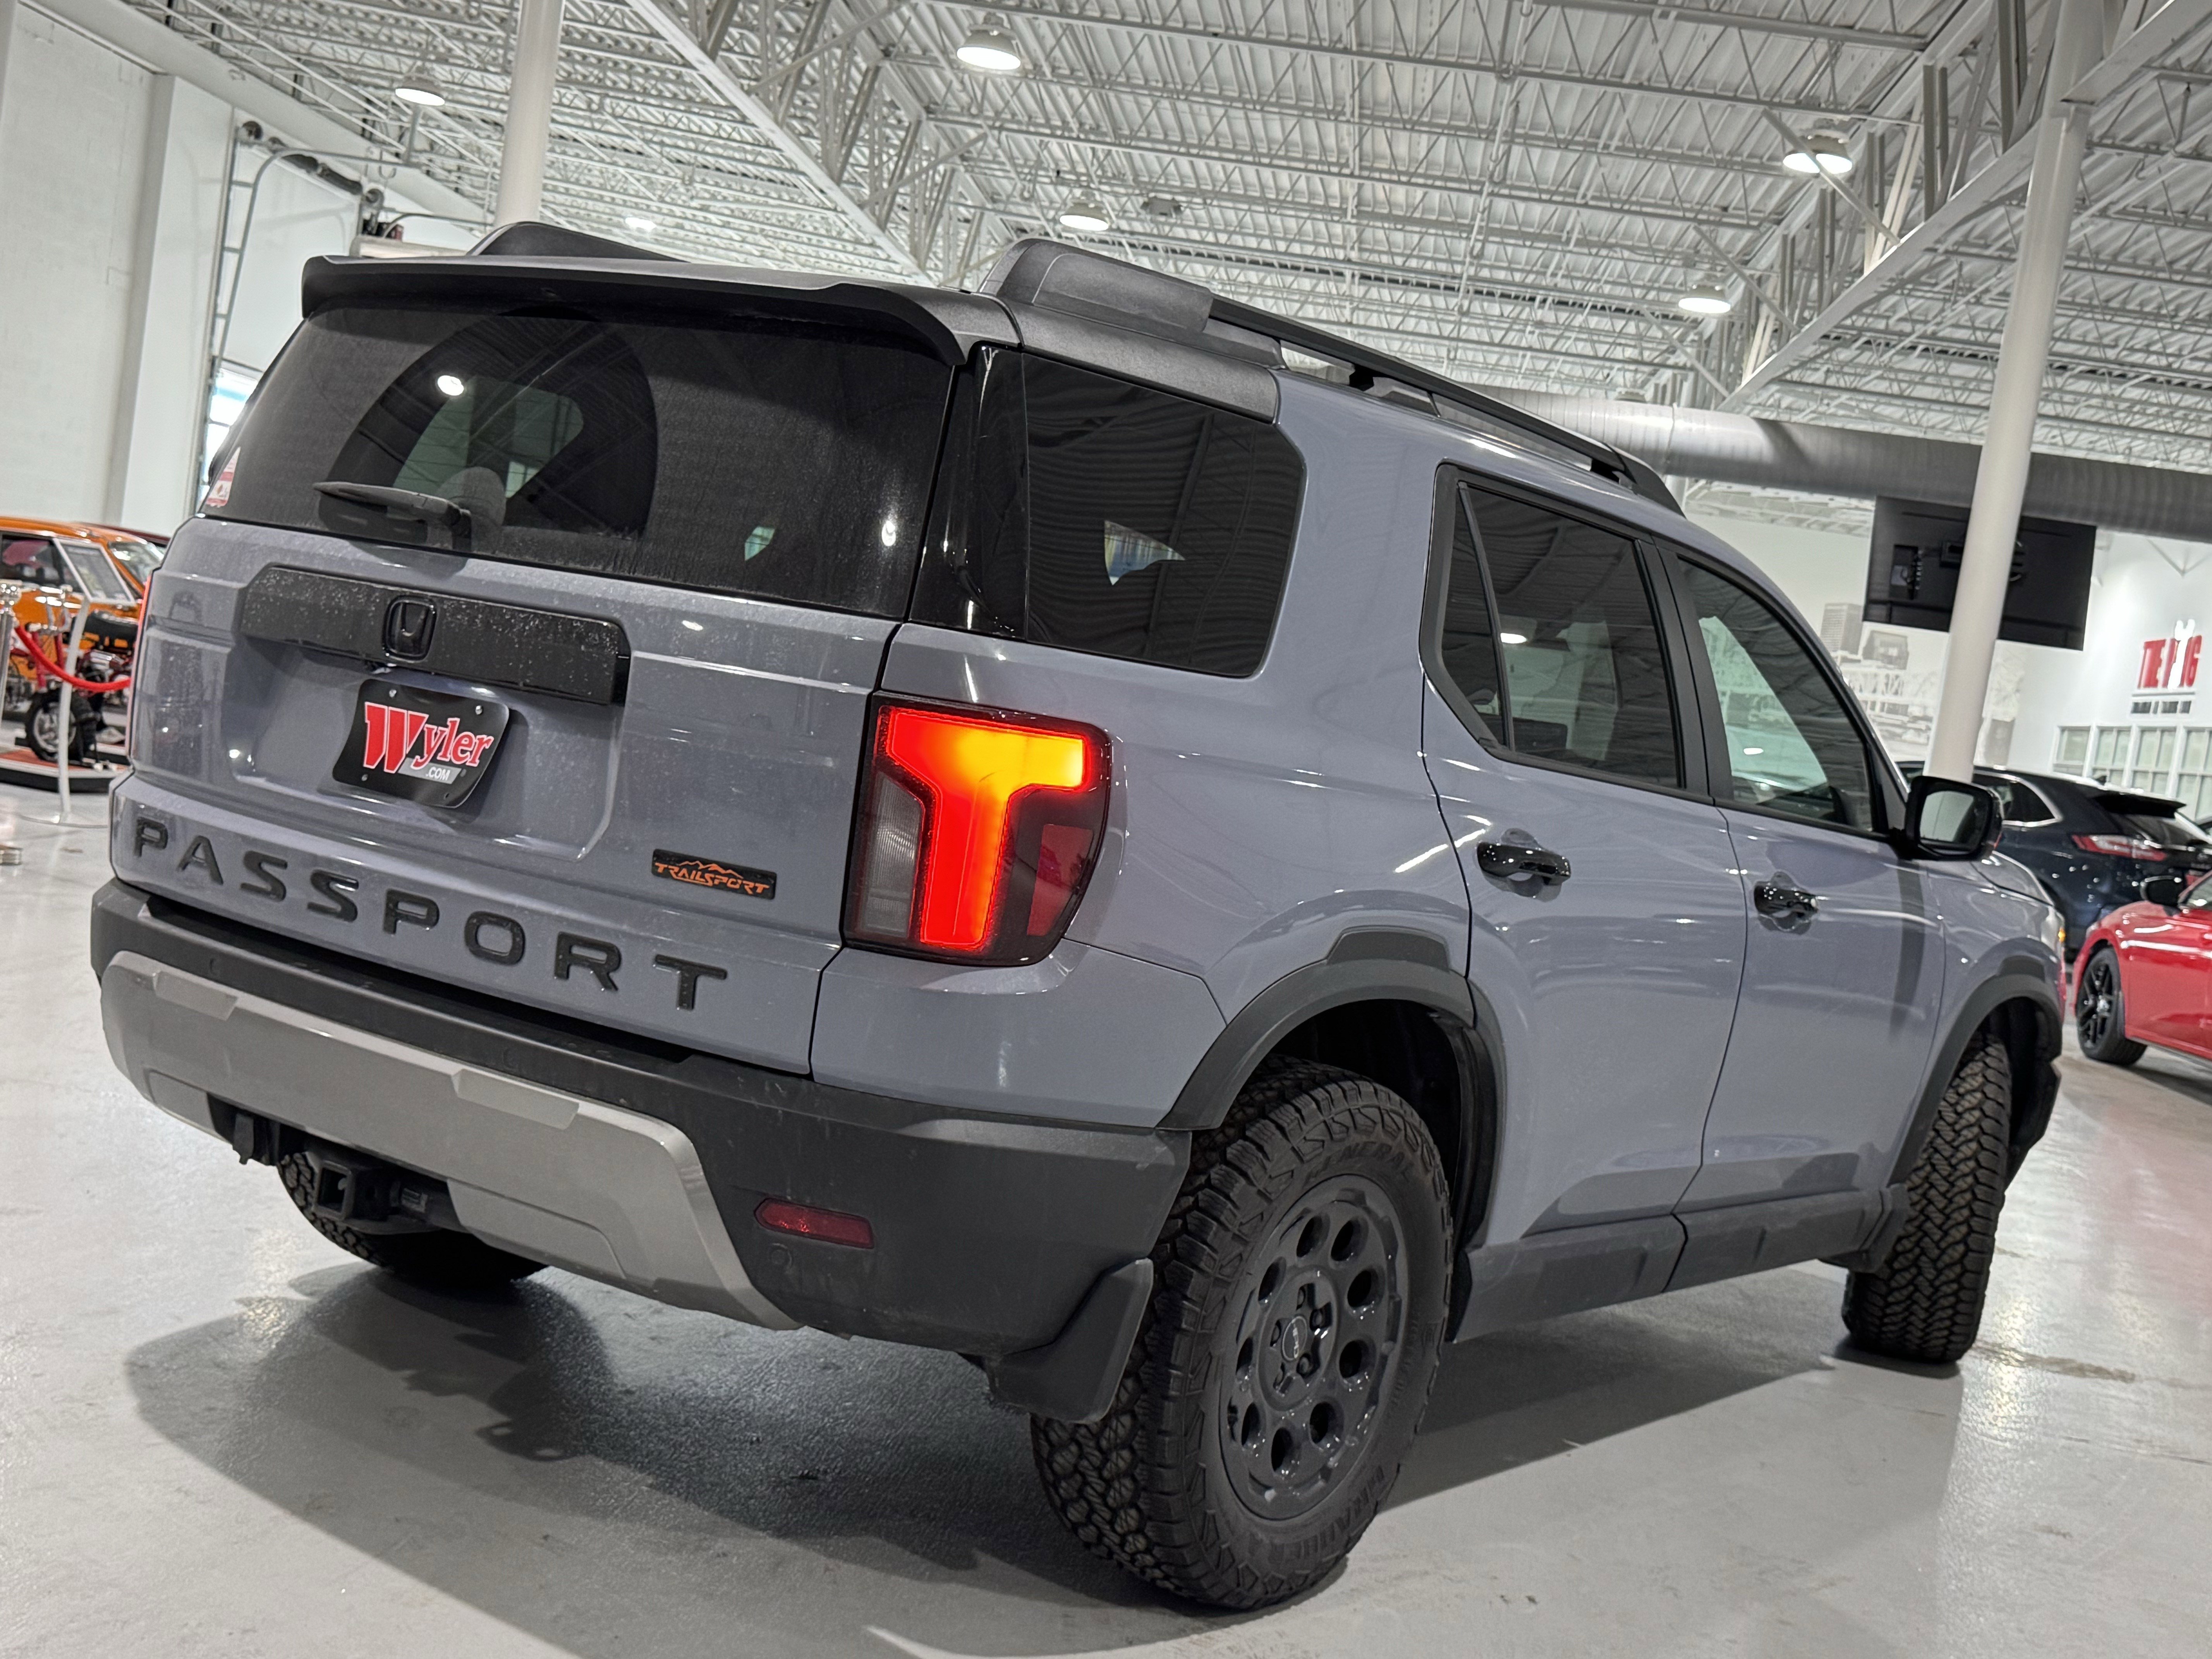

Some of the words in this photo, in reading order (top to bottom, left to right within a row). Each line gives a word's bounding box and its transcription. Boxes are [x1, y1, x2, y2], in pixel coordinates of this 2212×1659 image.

[363, 701, 494, 774] Wyler
[426, 766, 450, 781] .COM
[655, 862, 769, 895] TRAILSPORT
[133, 816, 728, 1012] PASSPORT
